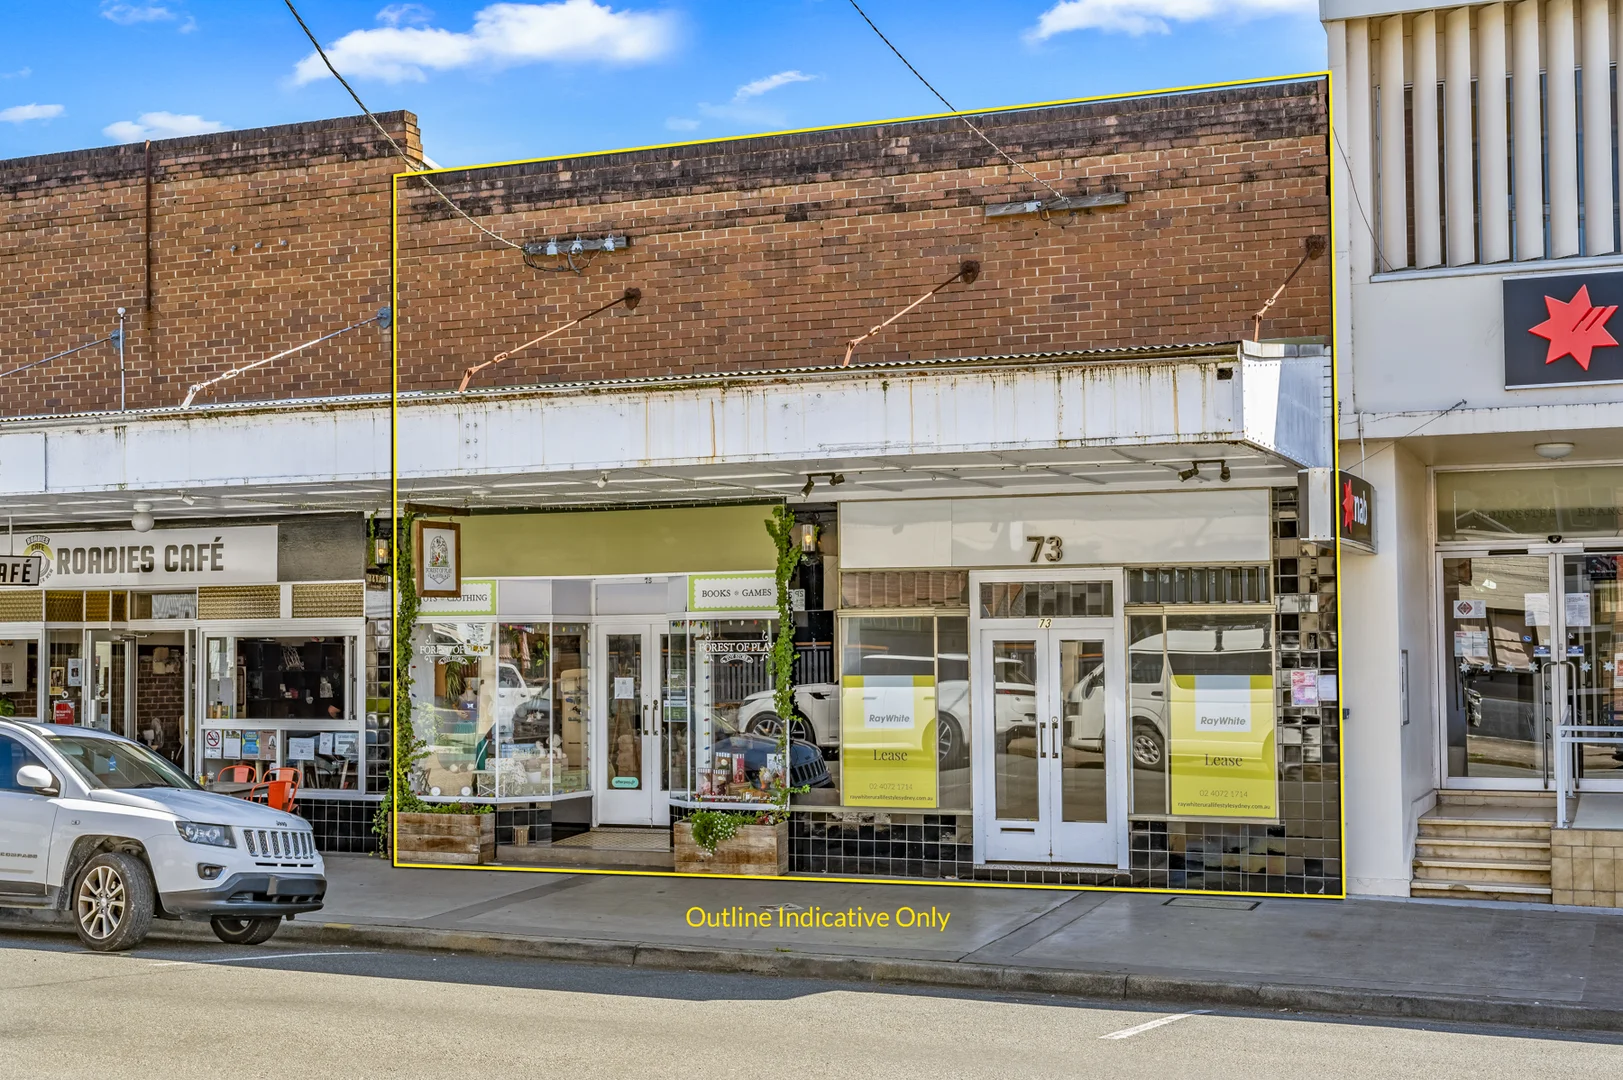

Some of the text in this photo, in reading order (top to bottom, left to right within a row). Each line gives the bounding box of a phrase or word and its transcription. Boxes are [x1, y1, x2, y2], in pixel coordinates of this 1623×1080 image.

[1354, 490, 1367, 526] nab
[1026, 536, 1063, 563] 73
[57, 537, 224, 575] ROADIES CAFÉ
[447, 594, 488, 602] CLOTHING
[702, 588, 772, 598] BOOKS GAMES
[1040, 618, 1052, 629] 73
[699, 642, 775, 652] FOREST OF PLAY
[873, 748, 908, 761] Lease
[1205, 753, 1243, 767] Lease
[897, 783, 913, 791] 1714
[1199, 789, 1209, 797] 02
[1231, 790, 1248, 798] 1714
